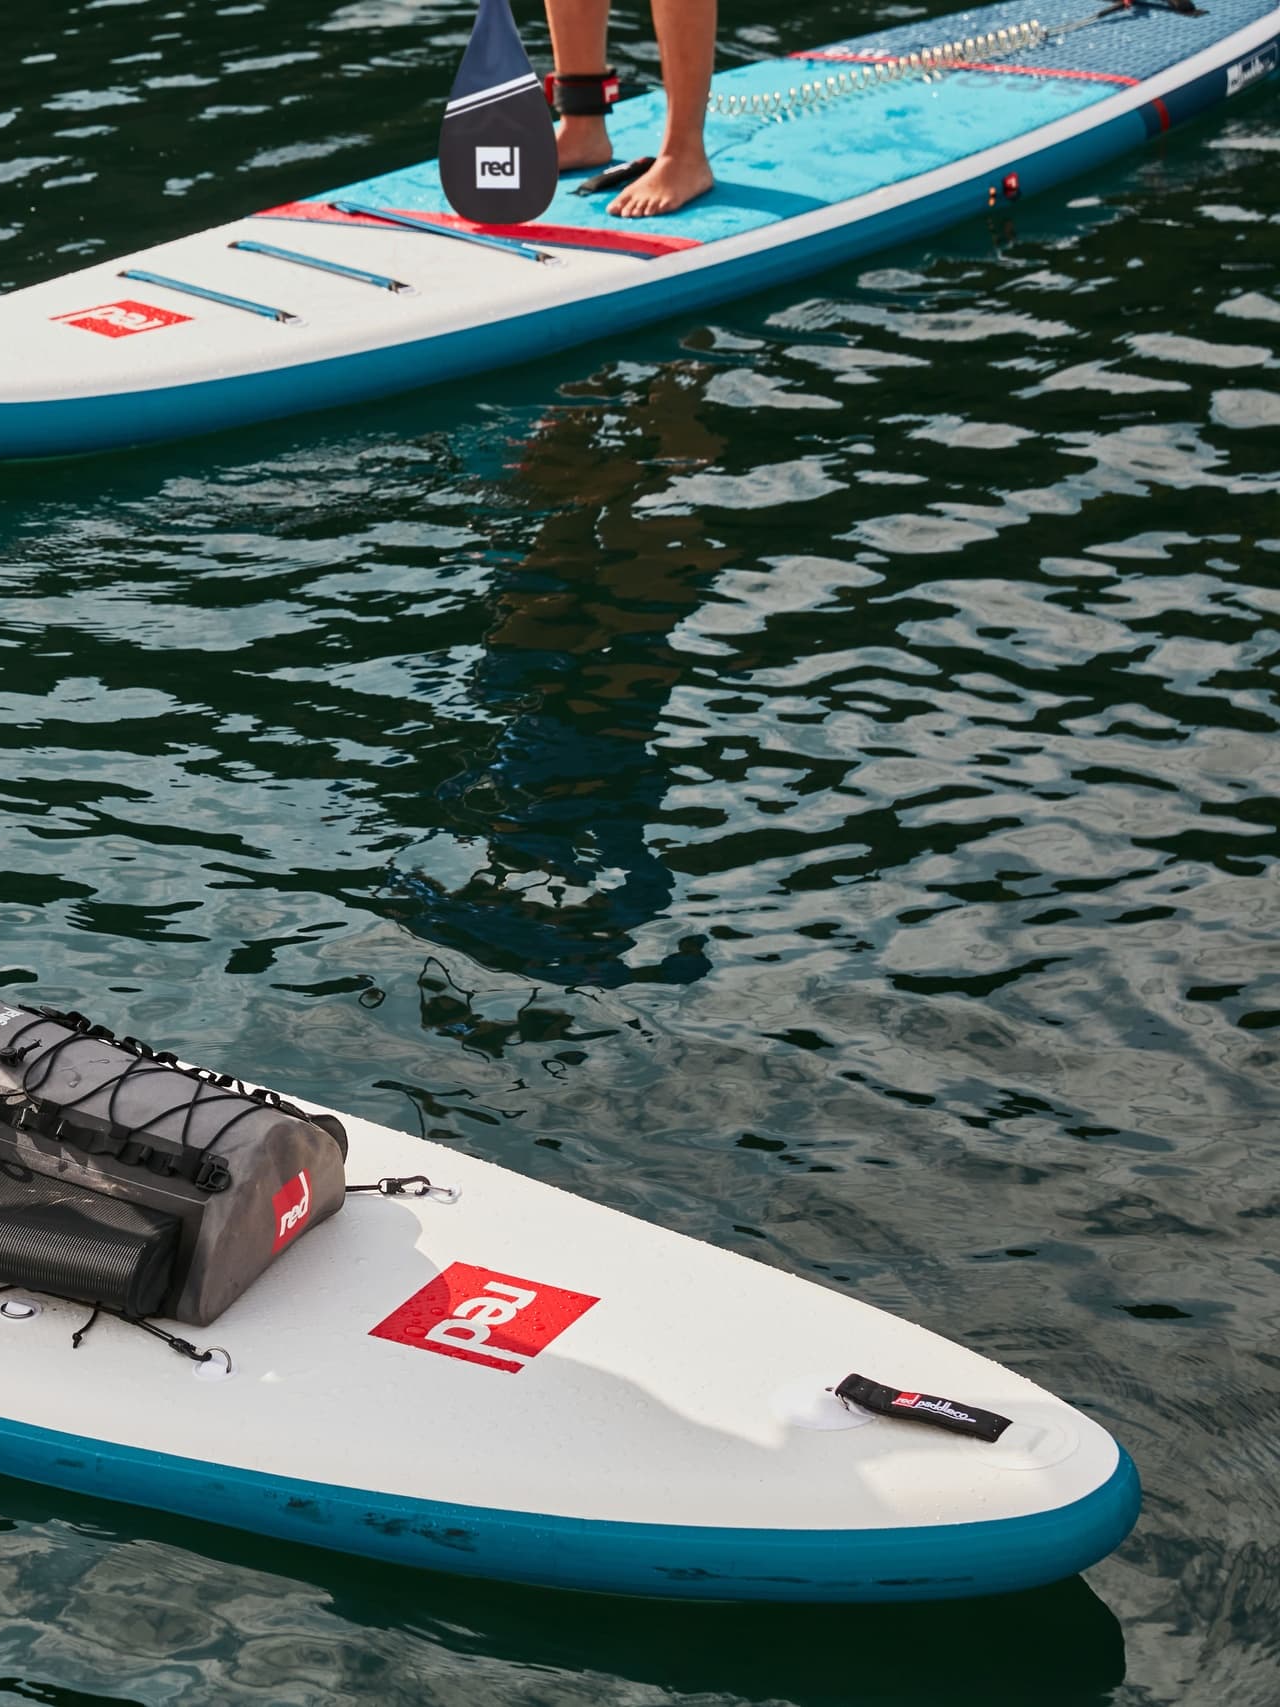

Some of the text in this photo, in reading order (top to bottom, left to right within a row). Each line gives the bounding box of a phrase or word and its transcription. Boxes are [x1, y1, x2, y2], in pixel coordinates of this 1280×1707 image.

[481, 147, 515, 176] red
[57, 306, 165, 331] red
[279, 1171, 310, 1237] red
[424, 1281, 538, 1365] red
[895, 1394, 920, 1405] red
